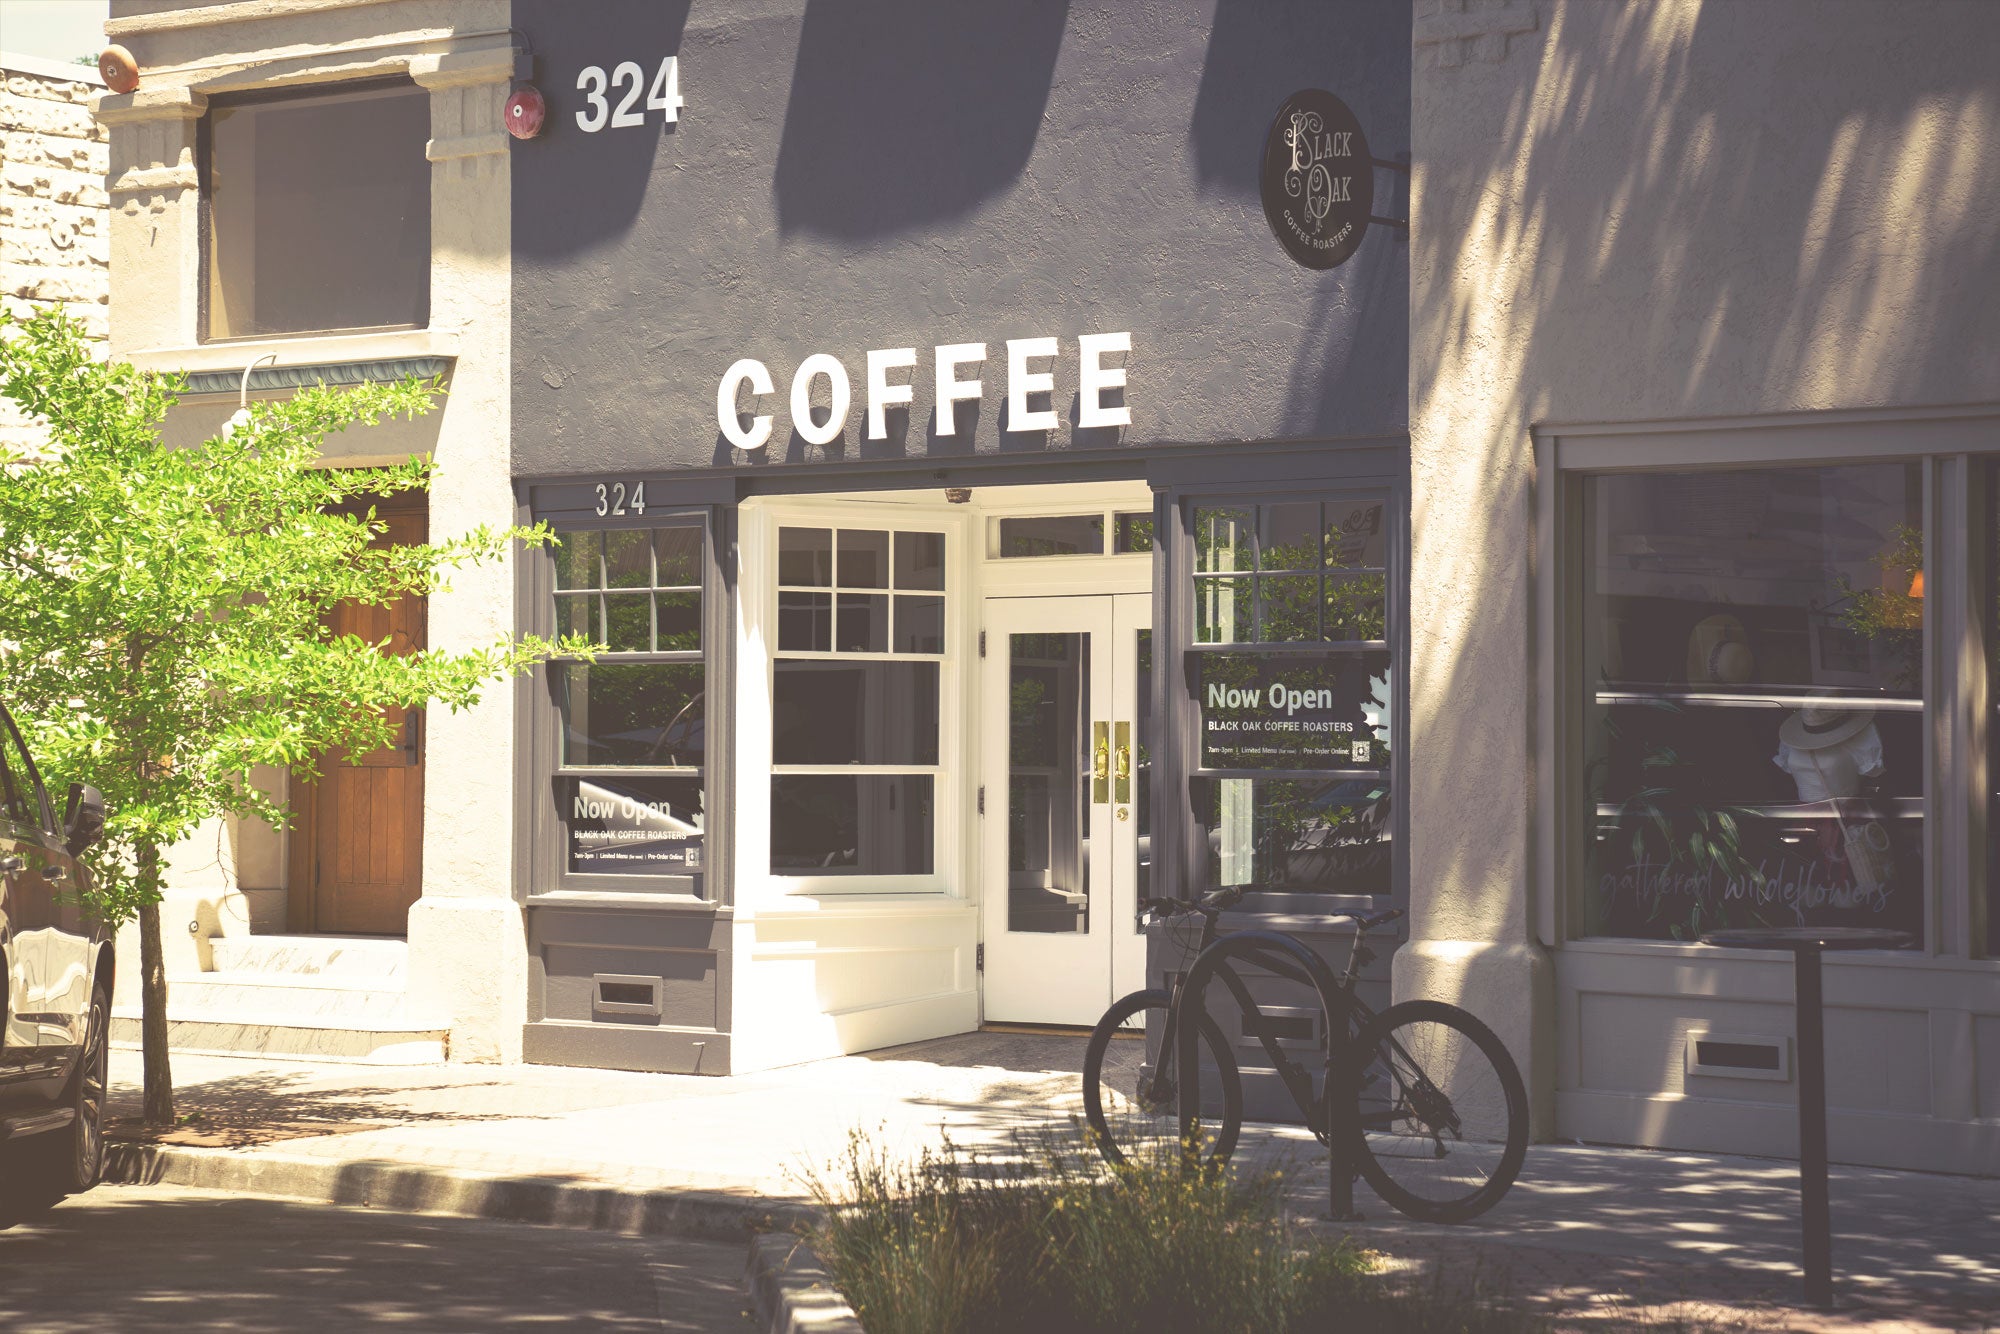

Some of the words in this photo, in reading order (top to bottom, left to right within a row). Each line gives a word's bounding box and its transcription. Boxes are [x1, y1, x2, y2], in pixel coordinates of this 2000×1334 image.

[576, 56, 684, 133] 324
[1284, 209, 1310, 245] COFFEE
[1313, 221, 1353, 250] ROASTERS
[717, 332, 1132, 450] COFFEE
[595, 481, 645, 517] 324
[1208, 683, 1261, 709] Now
[1269, 683, 1332, 716] Open
[1208, 721, 1239, 731] BLACK
[1242, 721, 1261, 731] OAK
[1264, 721, 1300, 732] COFFEE
[1302, 722, 1353, 732] ROASTERS
[1208, 746, 1234, 754] 7am-3pm
[1241, 746, 1261, 754] Limited
[1303, 747, 1329, 755] Pre-Order
[574, 796, 616, 819] Now
[621, 796, 671, 826] Open
[574, 830, 598, 839] BLACK
[600, 830, 616, 839] OAK
[618, 830, 646, 840] COFFEE
[647, 830, 687, 840] ROASTERS
[1600, 854, 1714, 919] gathered
